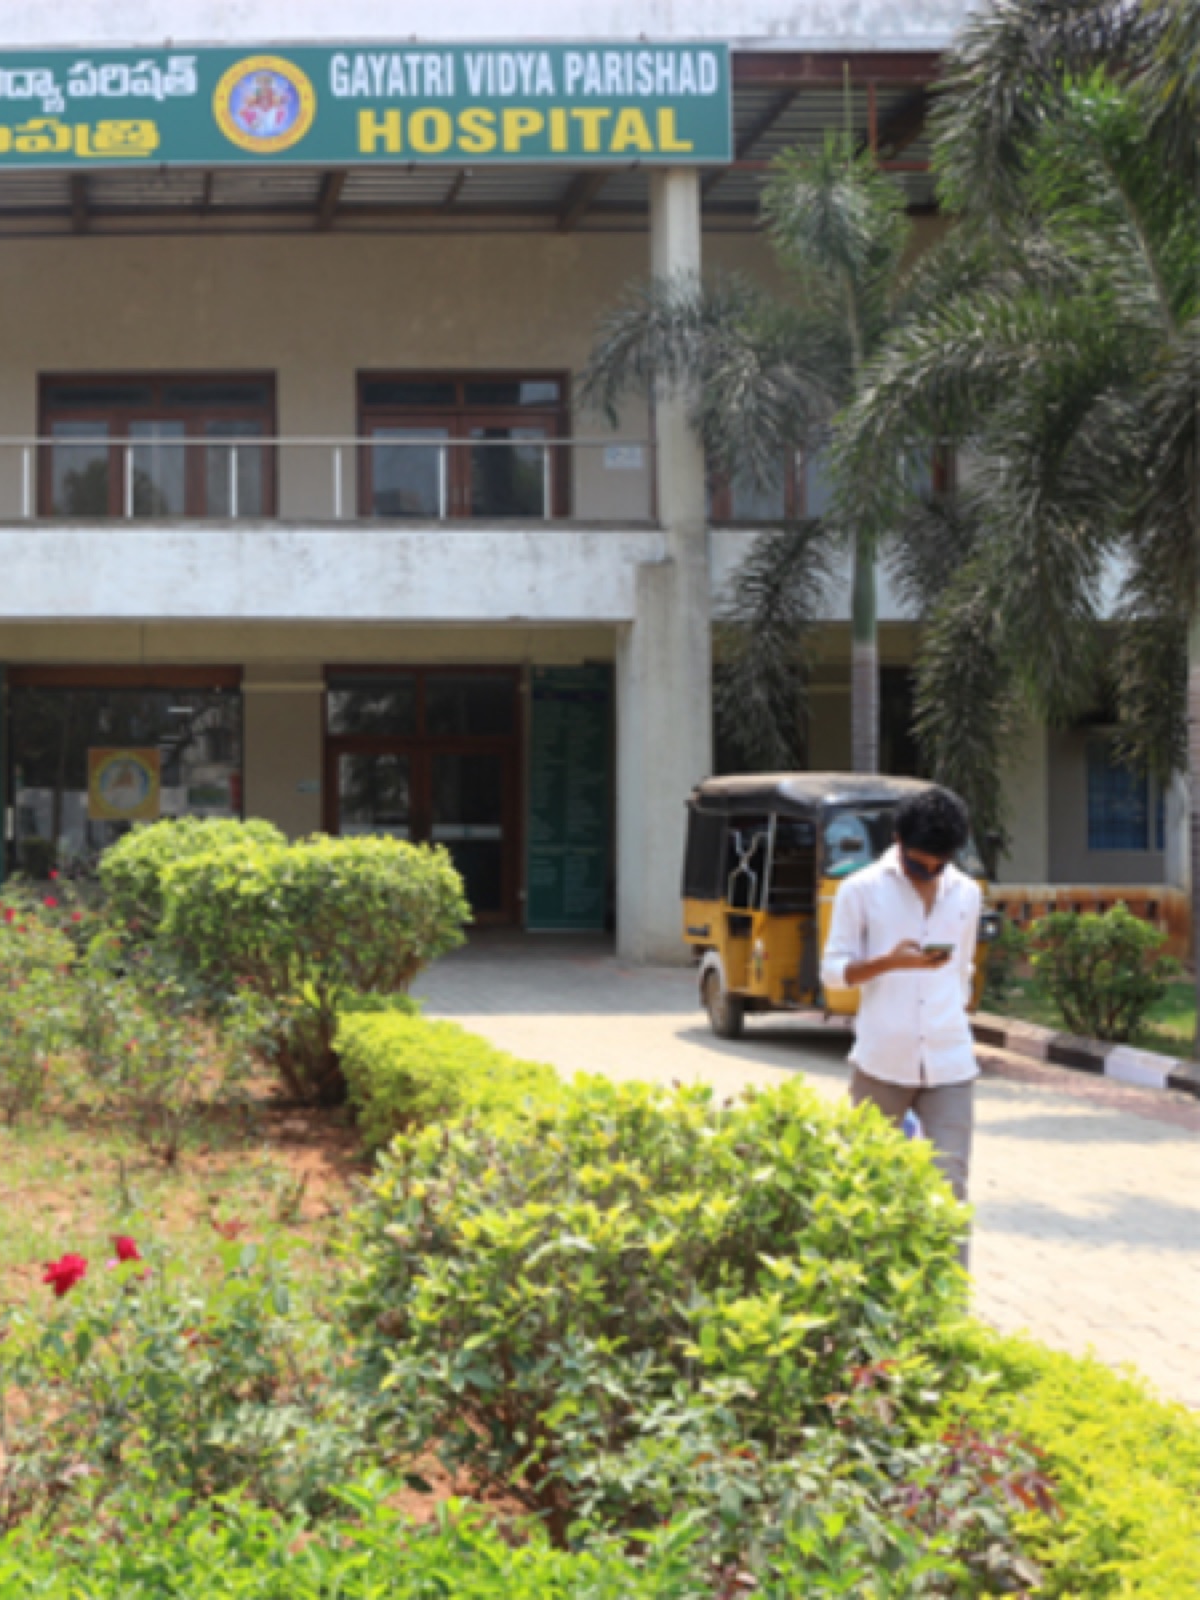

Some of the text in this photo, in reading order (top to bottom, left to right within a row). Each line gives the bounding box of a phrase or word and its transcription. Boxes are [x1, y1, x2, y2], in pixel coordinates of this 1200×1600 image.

[67, 55, 198, 101] పరిషత్
[329, 51, 719, 97] GAYATRI VIDYA PARISHAD
[358, 107, 694, 153] HOSPITAL
